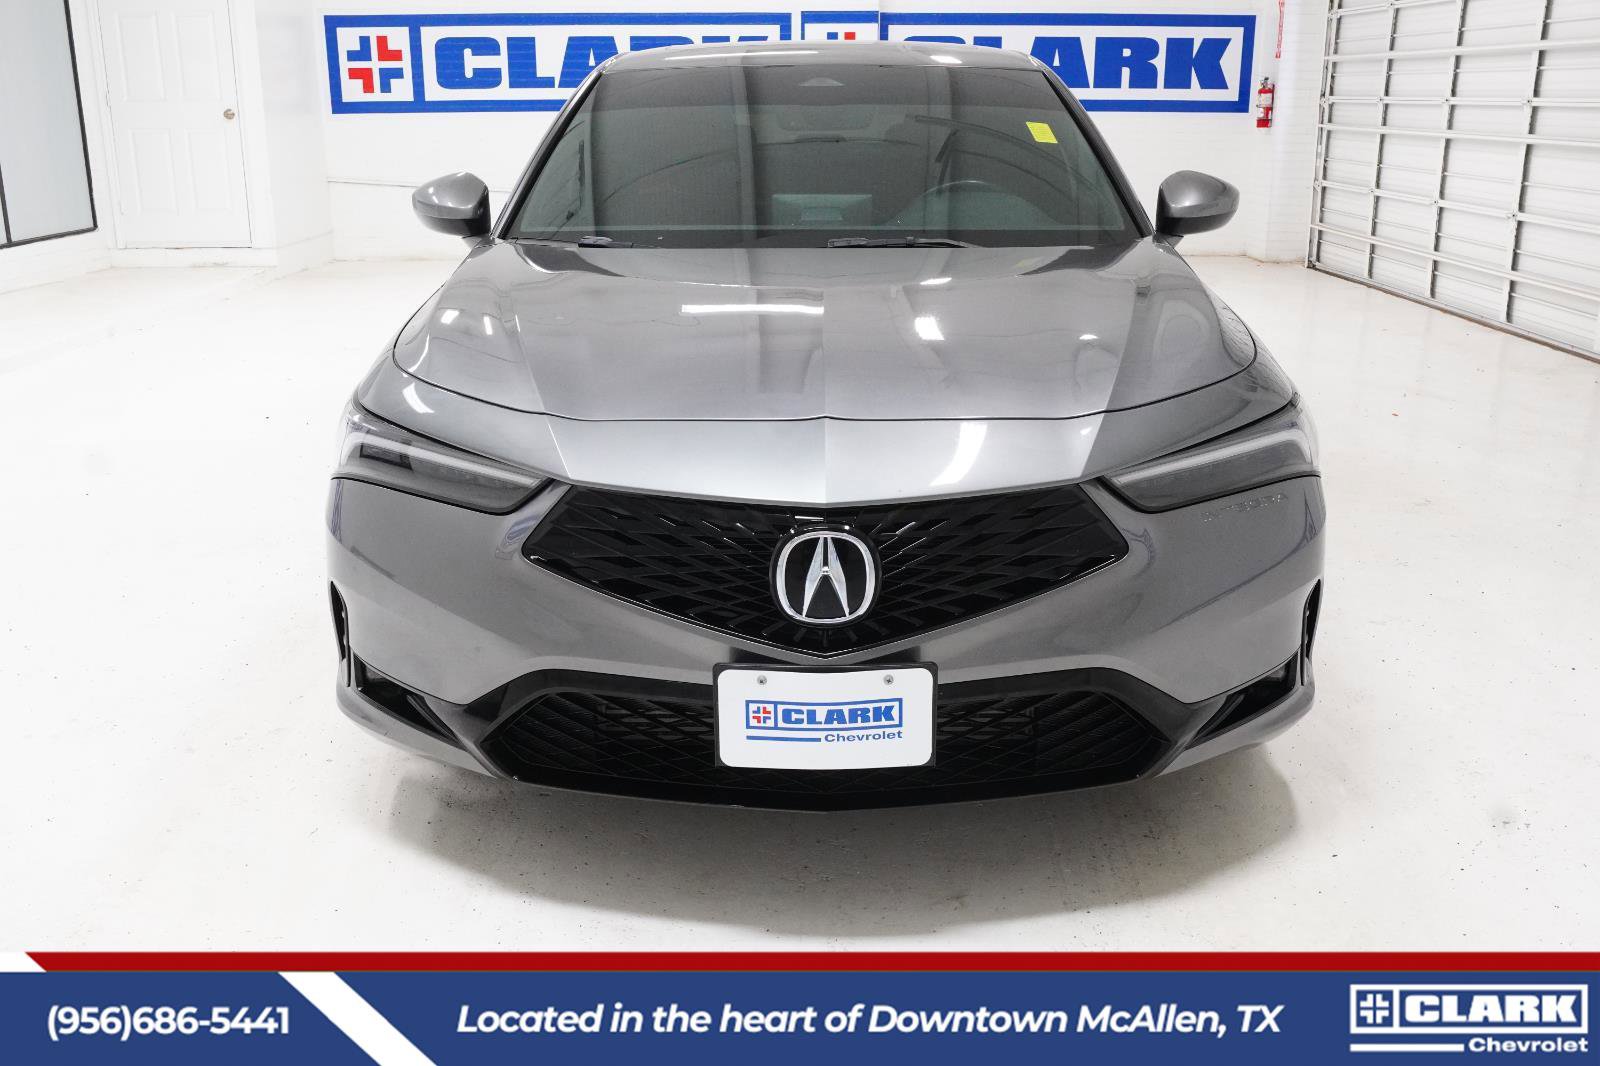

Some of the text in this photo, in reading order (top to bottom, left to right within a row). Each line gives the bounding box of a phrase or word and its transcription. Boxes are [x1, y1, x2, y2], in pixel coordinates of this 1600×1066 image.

[434, 35, 768, 90] CLA
[903, 35, 1233, 90] ARK
[781, 705, 895, 725] CLARK
[824, 730, 903, 743] Chevrolet
